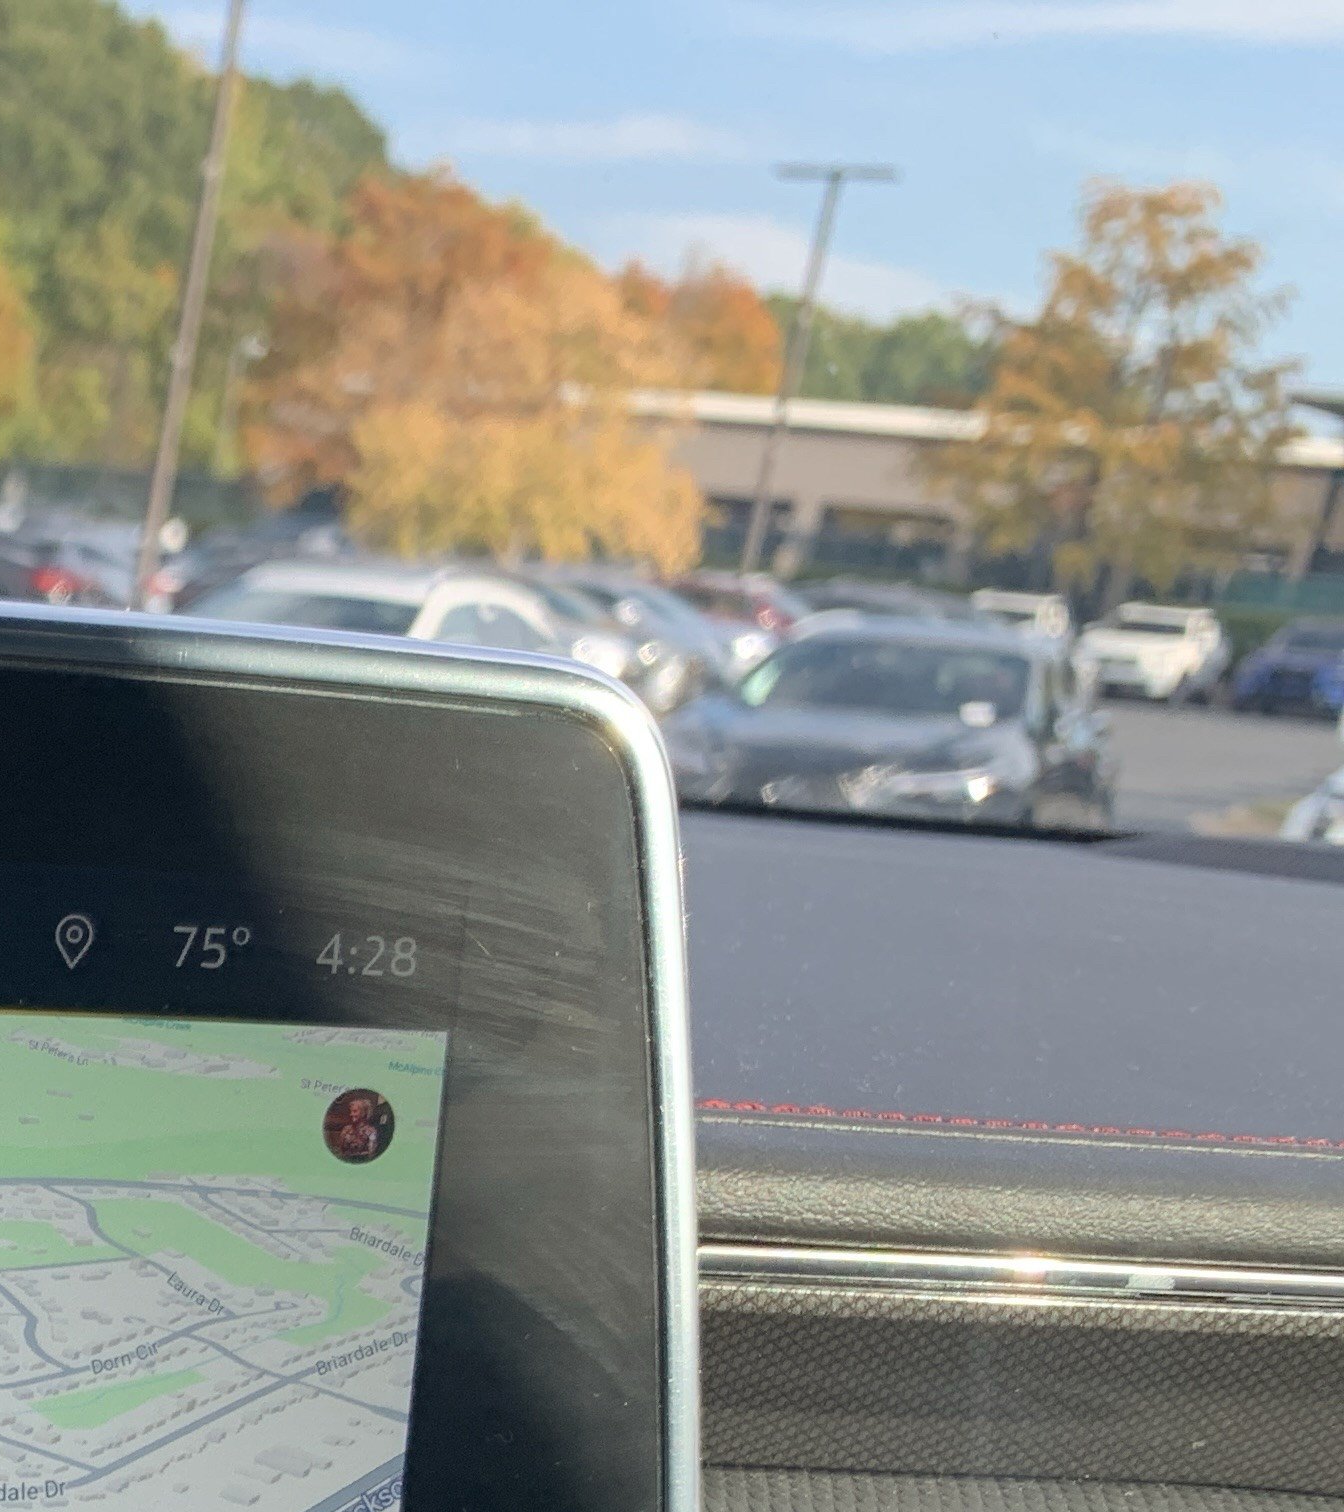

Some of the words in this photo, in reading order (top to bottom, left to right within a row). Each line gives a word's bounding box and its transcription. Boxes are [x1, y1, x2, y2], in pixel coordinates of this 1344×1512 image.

[315, 932, 418, 977] 4:28
[349, 1226, 412, 1262] Briardale
[166, 1271, 207, 1308] Laura
[90, 1354, 132, 1375] Dorn
[135, 1342, 160, 1360] Cir
[315, 1339, 390, 1377] Briardale
[392, 1330, 412, 1347] Dr
[44, 1479, 67, 1499] Dr
